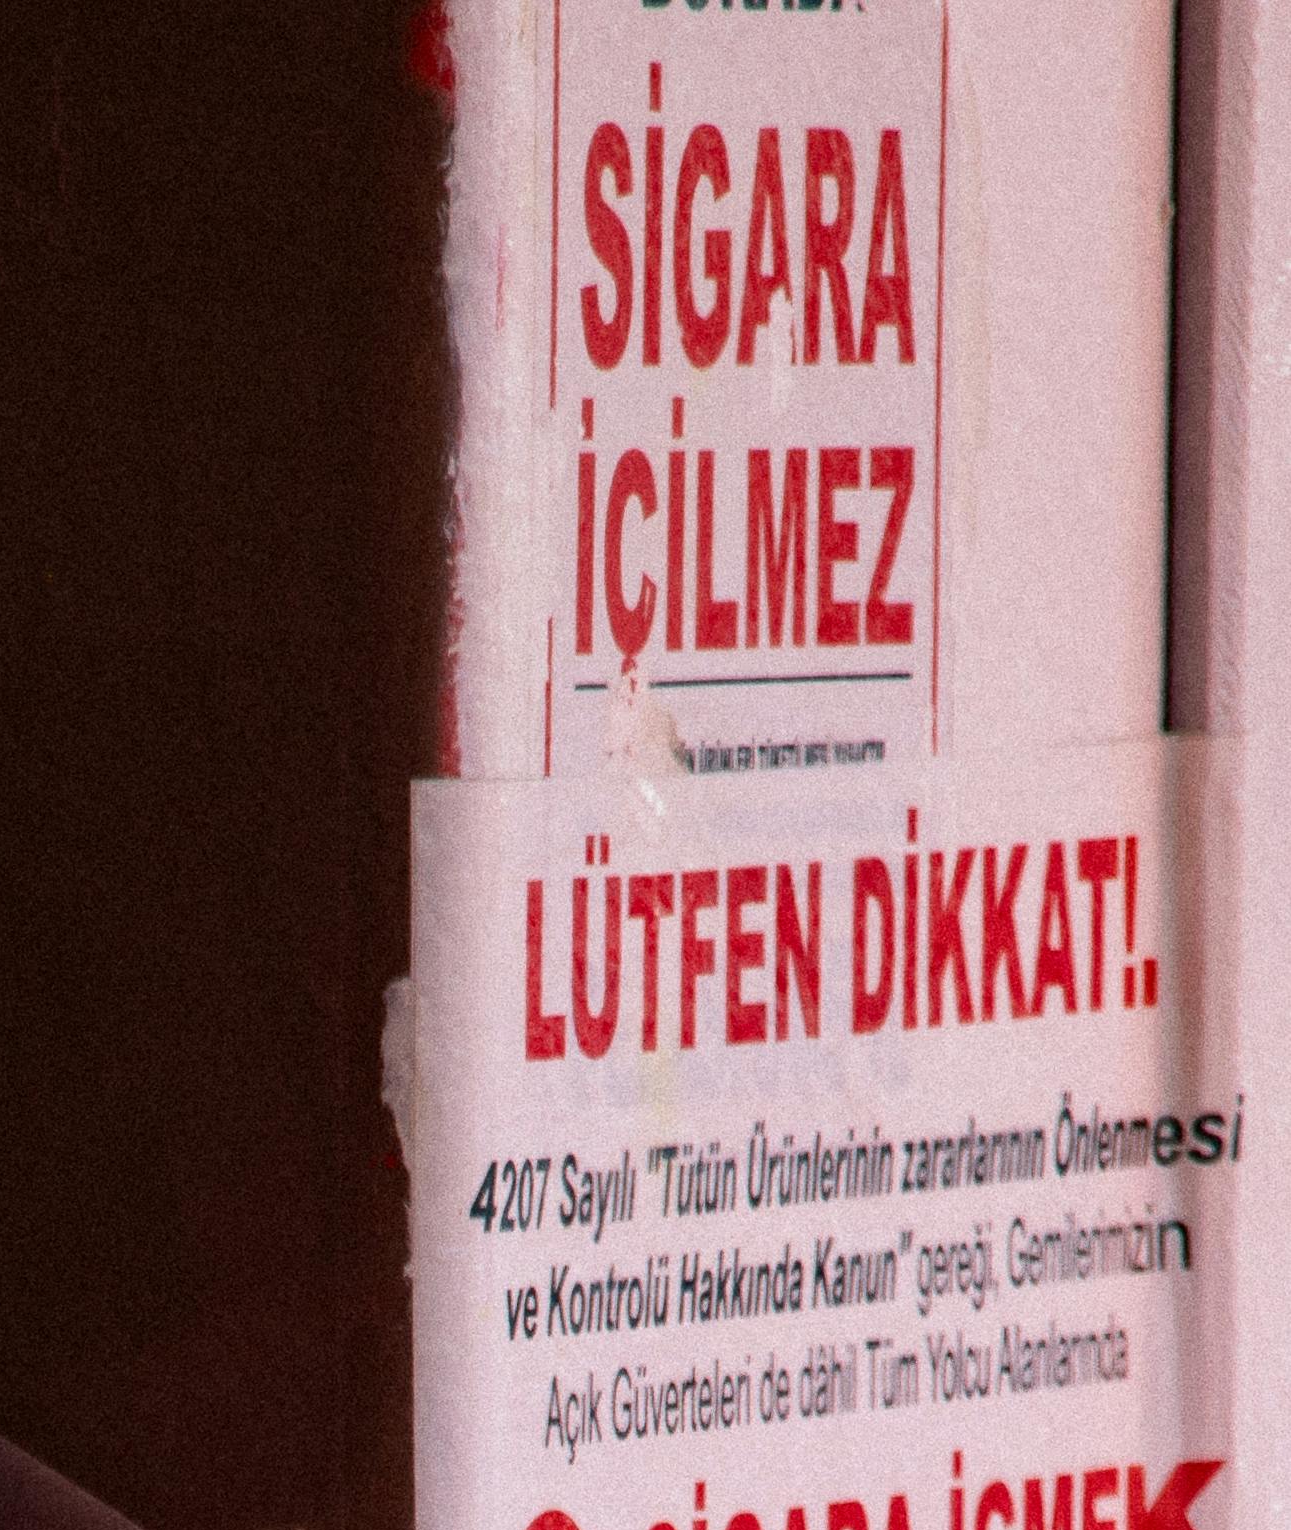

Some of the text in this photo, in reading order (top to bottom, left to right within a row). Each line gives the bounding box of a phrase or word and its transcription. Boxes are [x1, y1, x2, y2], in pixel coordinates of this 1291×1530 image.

[580, 61, 916, 371] SİGARA
[575, 397, 916, 682] İÇİLMEZ
[525, 833, 823, 1062] LÜTFEN
[469, 1157, 552, 1233] 4207
[558, 1148, 637, 1244] Sayılı
[647, 1140, 738, 1218] "Tütün
[746, 1119, 896, 1210] Ürünlerinin
[1053, 1088, 1246, 1178] Önlenmesi
[505, 1284, 539, 1342] ve
[546, 1255, 671, 1337] Kontrolü
[677, 1242, 806, 1324] Hakkında
[811, 1229, 914, 1309] Kanun"
[543, 1371, 603, 1466] Açık
[610, 1354, 752, 1441] Güverteleri
[758, 1352, 792, 1424] de
[864, 1336, 920, 1409] Tüm
[926, 1331, 992, 1402] Yolcu
